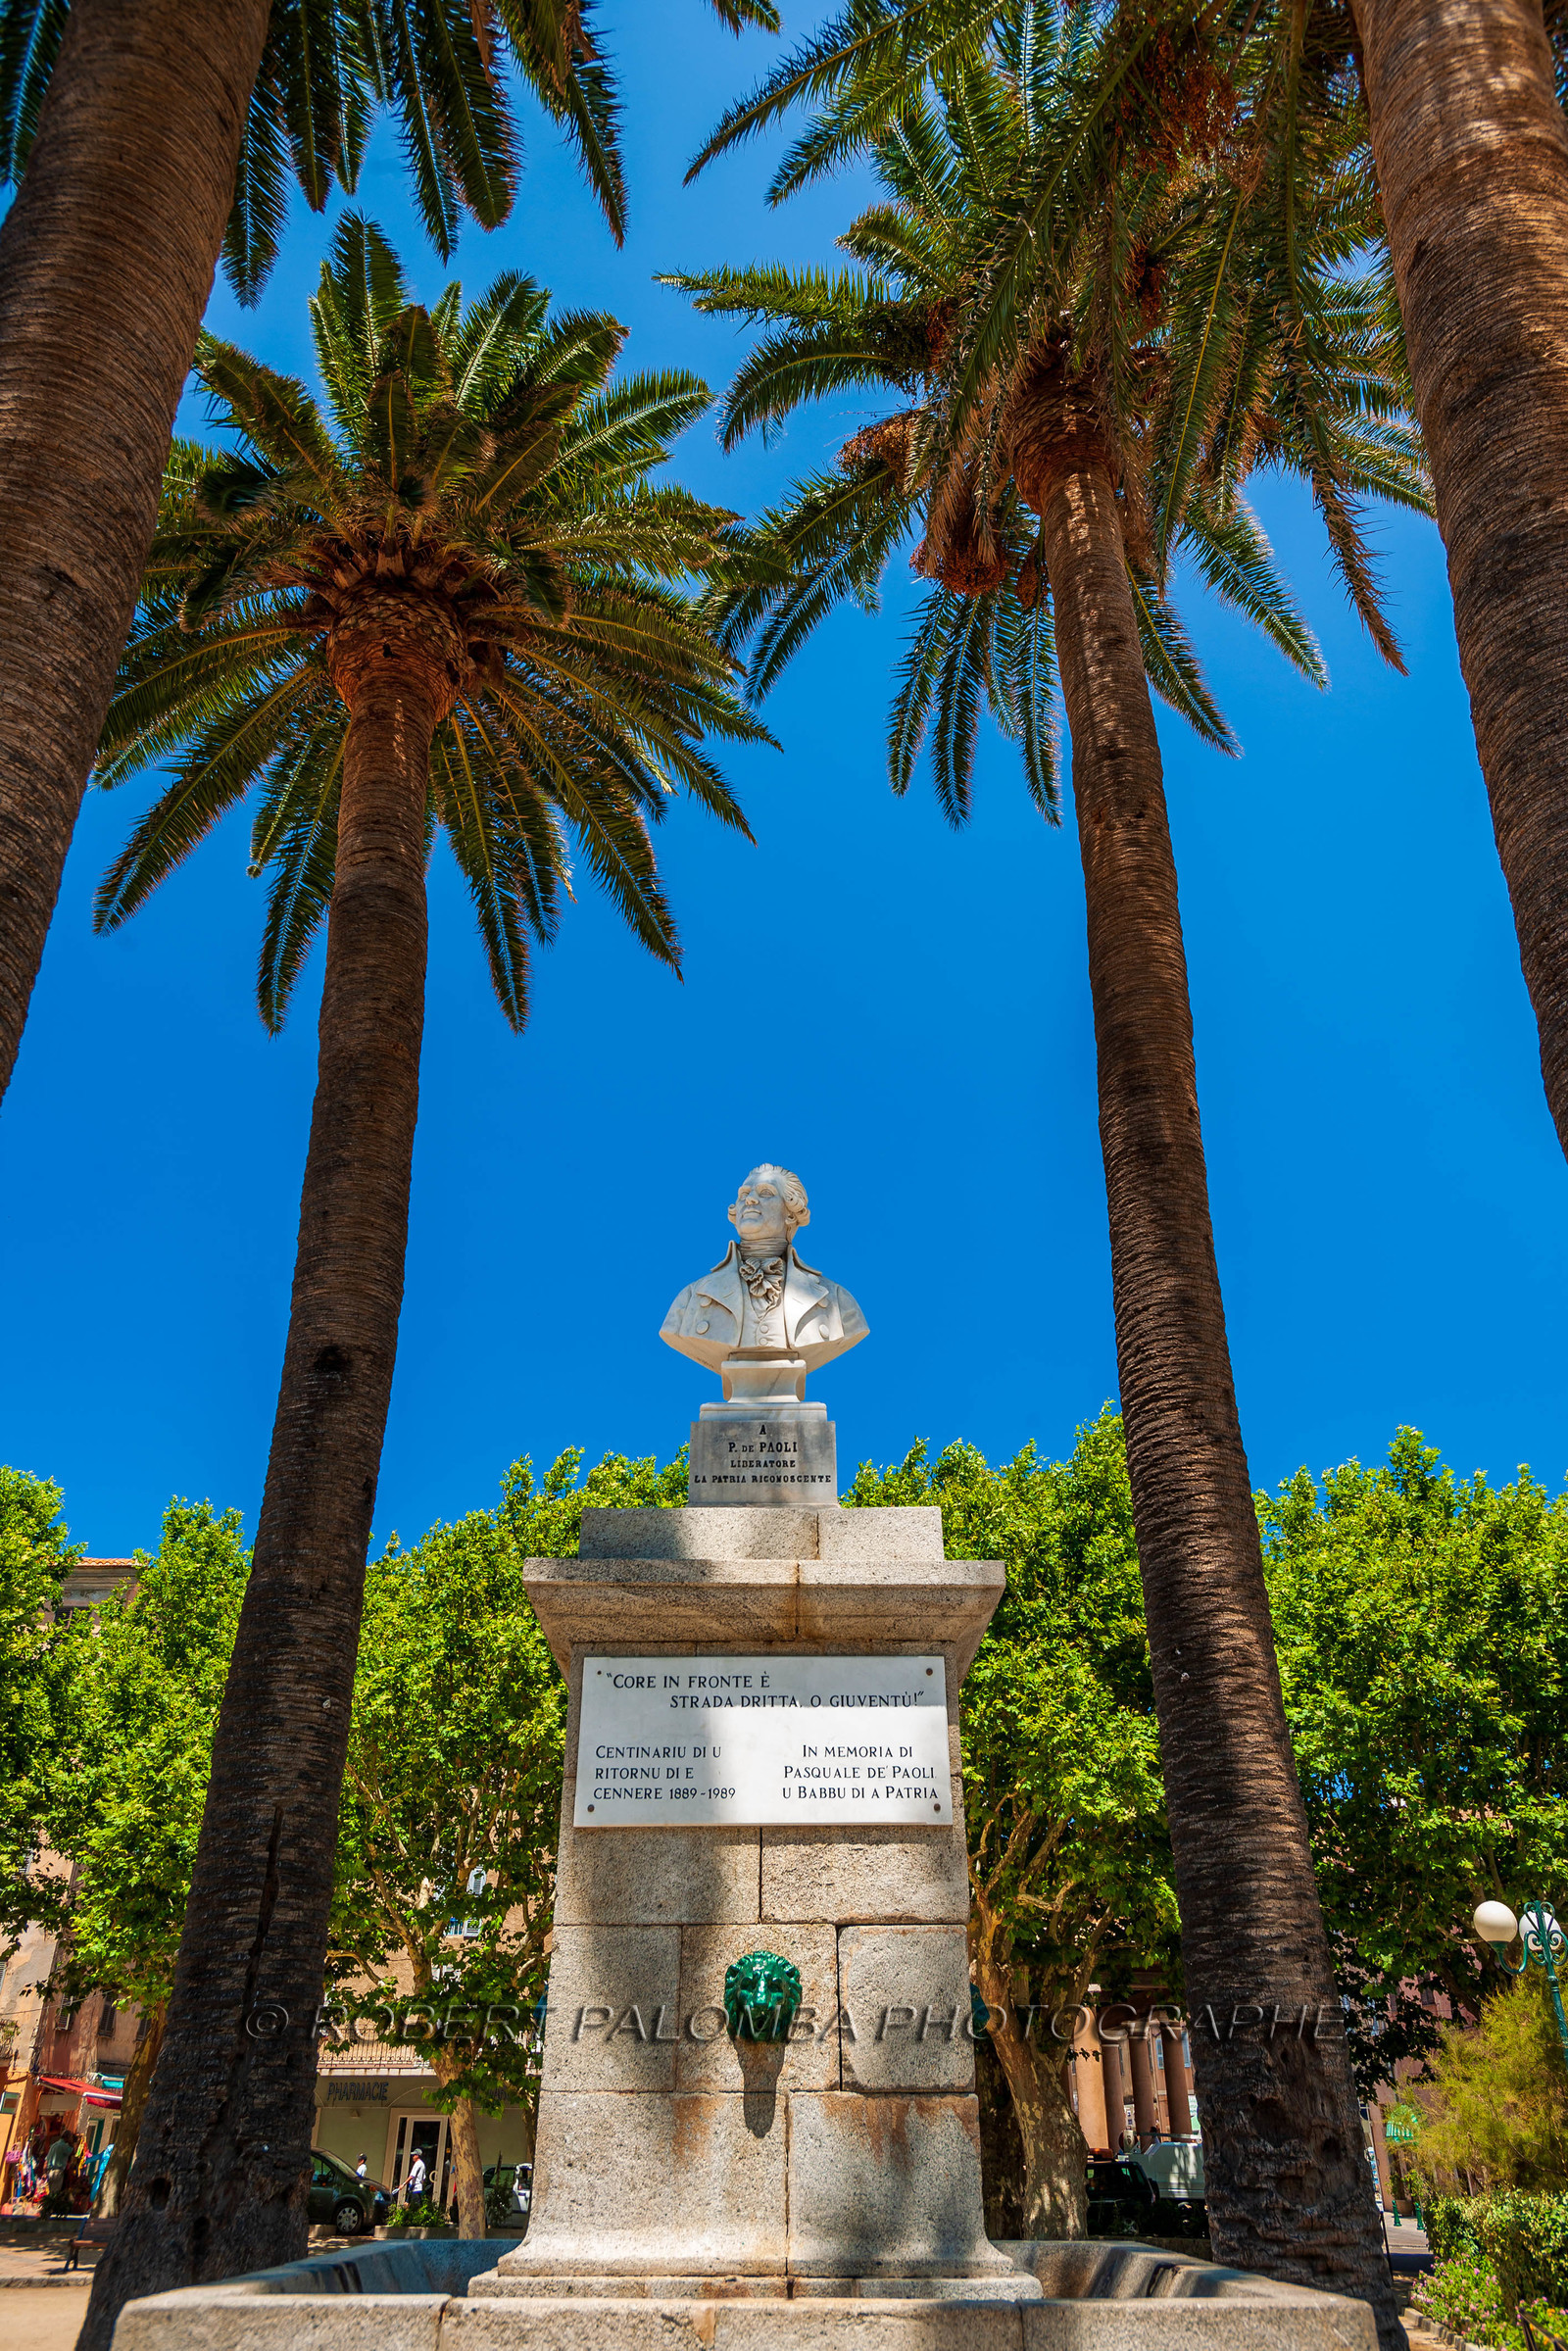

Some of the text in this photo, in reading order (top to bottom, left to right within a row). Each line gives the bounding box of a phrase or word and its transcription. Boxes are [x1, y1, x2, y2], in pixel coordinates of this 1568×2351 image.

[759, 1424, 767, 1435] A
[728, 1442, 738, 1452] P.
[760, 1442, 798, 1452] PAOLI
[730, 1459, 796, 1468] LIBERATORE
[694, 1475, 832, 1484] LA PATRIA RICONOSCENTE
[663, 1675, 680, 1689] IN
[688, 1675, 753, 1689] FRONTE
[669, 1694, 734, 1708] STRADA
[810, 1694, 821, 1707] O
[595, 1744, 721, 1758] CENTINARIU DI U
[803, 1744, 913, 1758] IN MEMORIA DI
[595, 1767, 694, 1780] RITORNU DI E
[784, 1765, 860, 1779] PASQUALE
[593, 1788, 662, 1800] CENNERE
[782, 1786, 939, 1799] U BABBU DI A PATRIA
[326, 2081, 389, 2101] PHARMACIE
